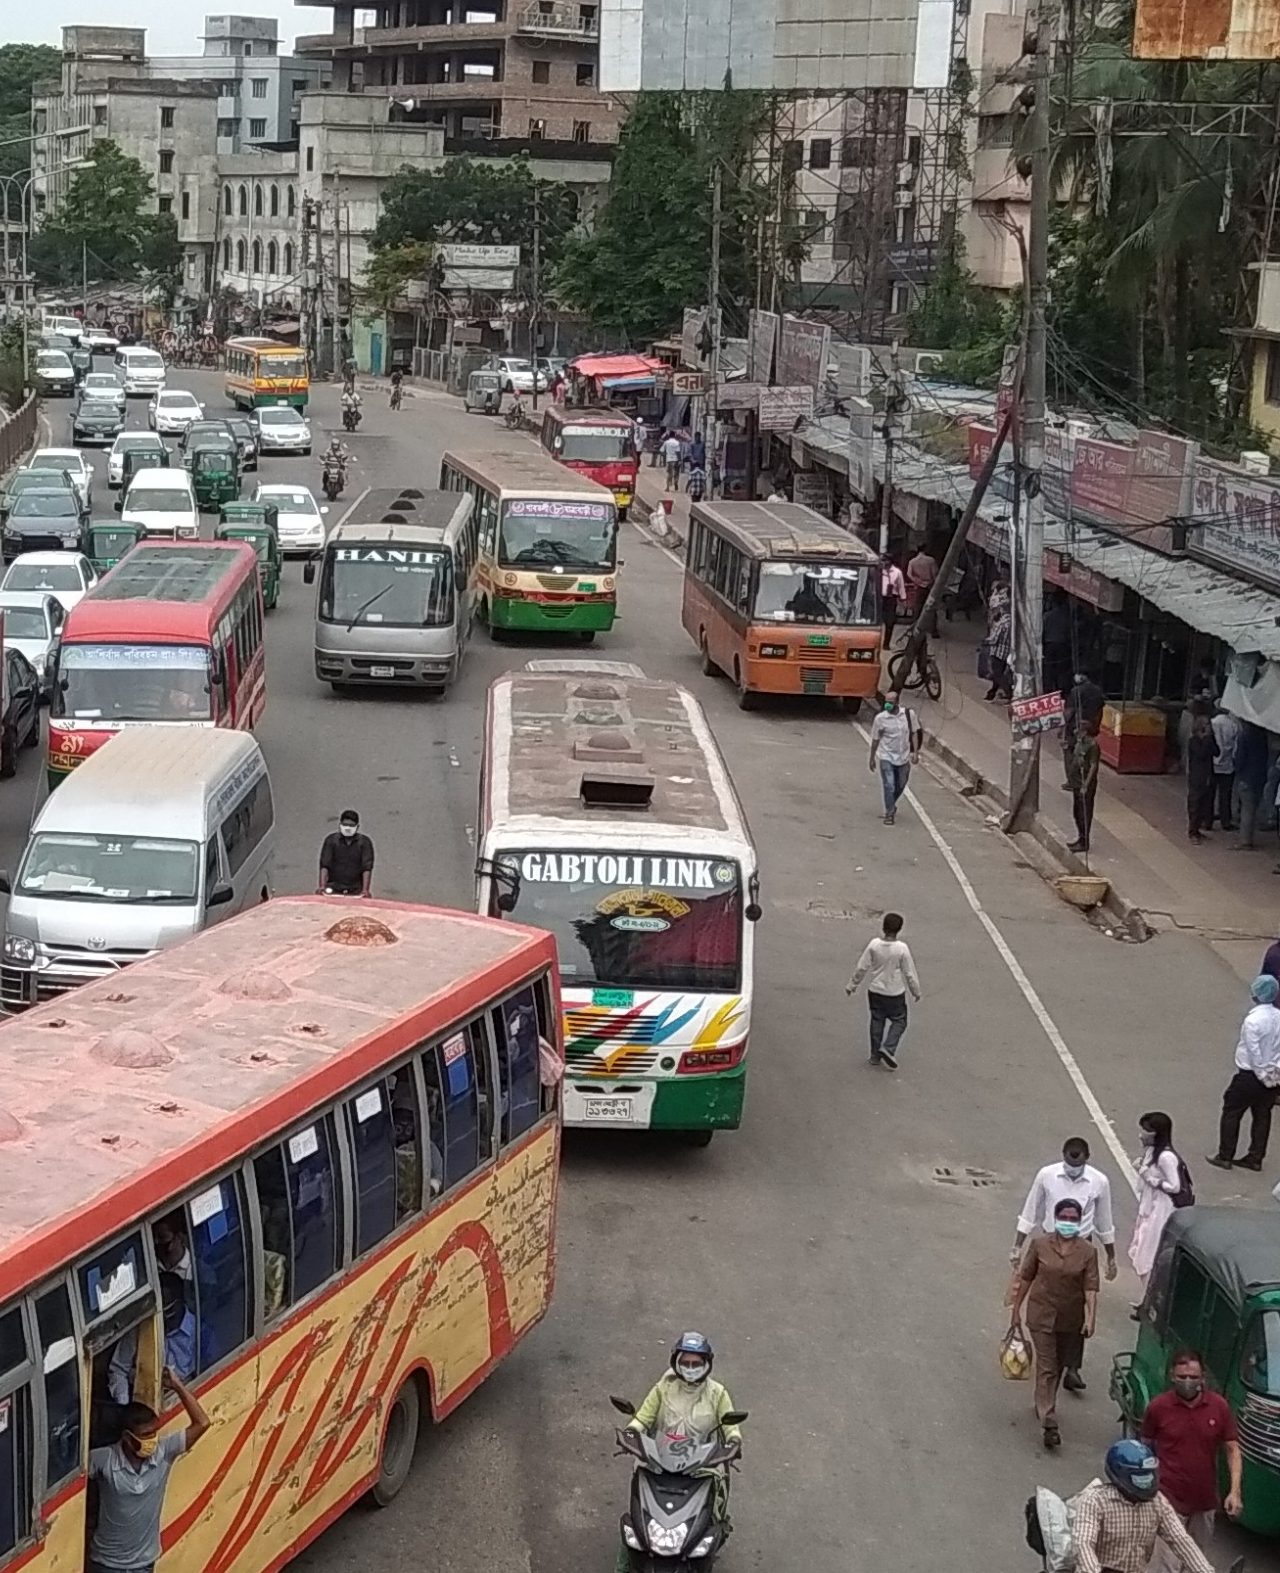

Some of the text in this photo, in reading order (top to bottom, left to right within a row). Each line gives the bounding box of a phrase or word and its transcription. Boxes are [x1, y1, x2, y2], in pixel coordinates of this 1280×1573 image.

[334, 549, 445, 564] HANIF
[806, 567, 859, 581] JR
[521, 853, 715, 889] GABTOLI LINK
